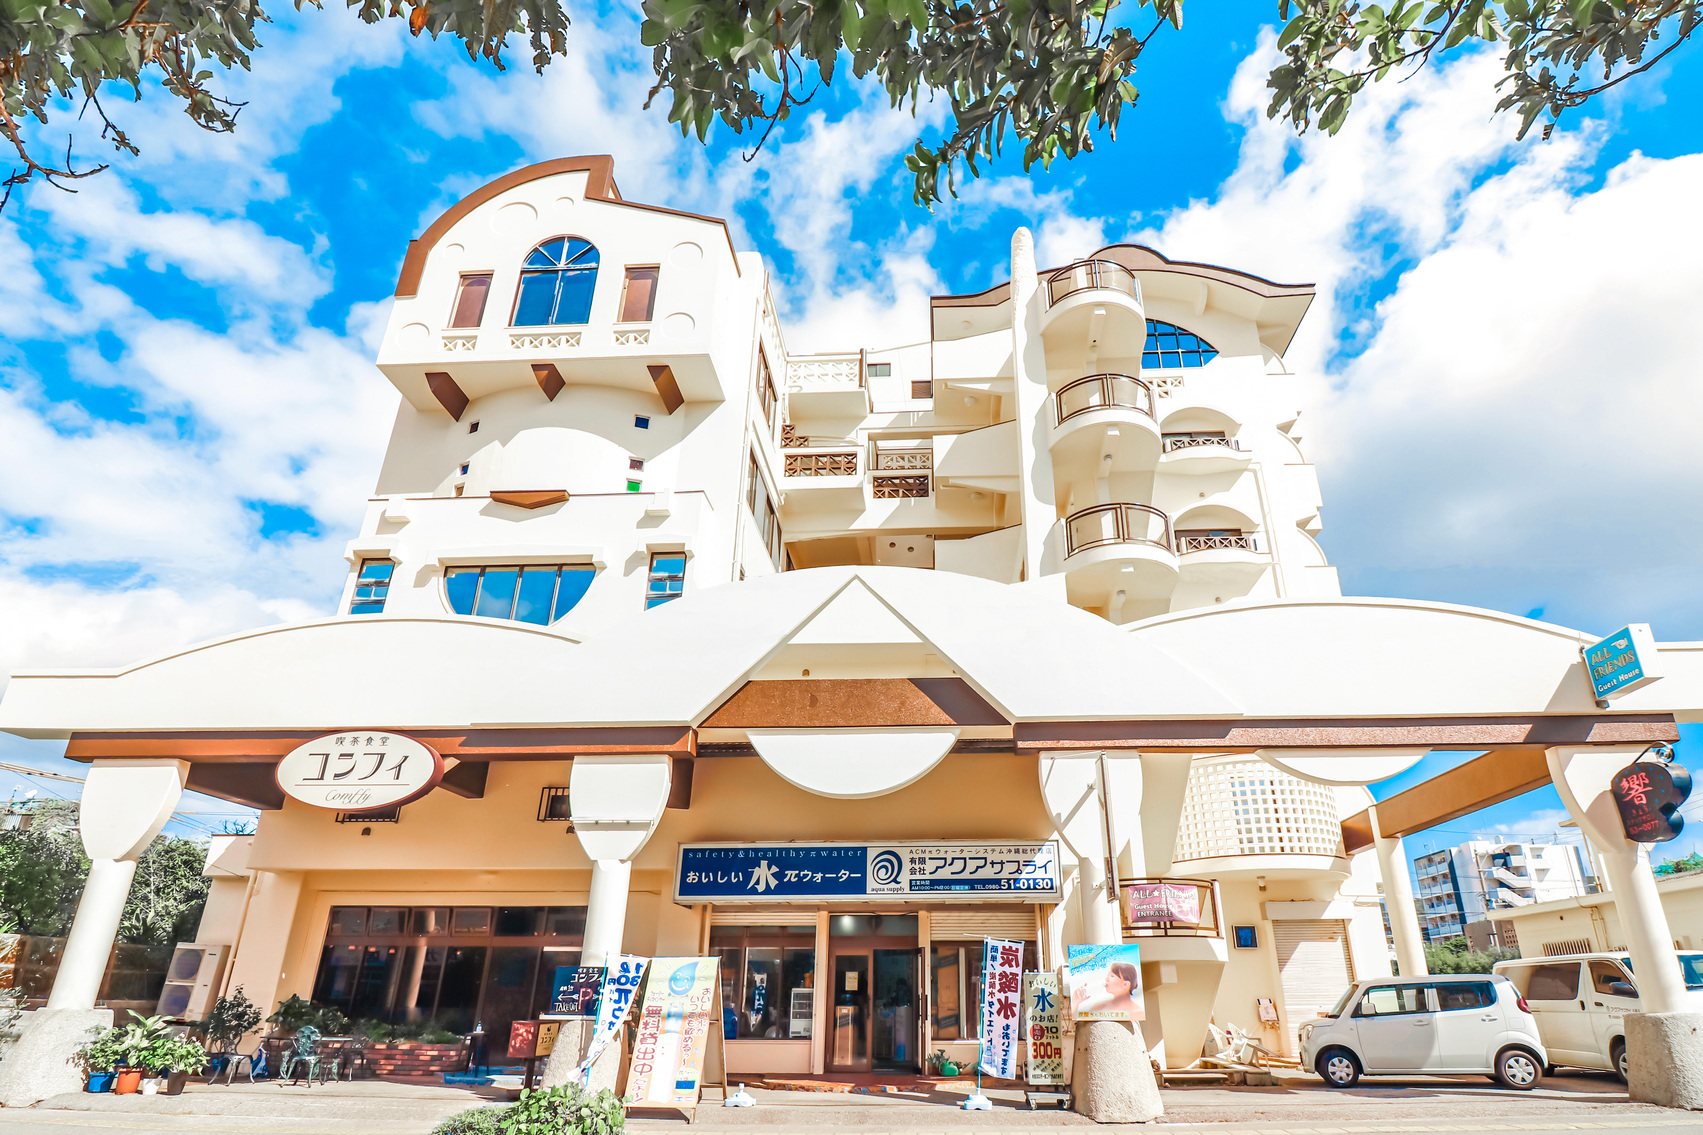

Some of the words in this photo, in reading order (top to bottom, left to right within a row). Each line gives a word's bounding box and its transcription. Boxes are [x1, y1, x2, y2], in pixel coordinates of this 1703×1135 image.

[1591, 647, 1612, 666] ALL
[1593, 649, 1635, 681] FRIENDS
[1598, 679, 1617, 692] Guest
[1618, 668, 1640, 682] House
[335, 736, 390, 746] 喫茶食堂
[302, 752, 409, 781] コンフィ
[1620, 772, 1653, 805] 響
[928, 857, 1052, 875] アクアサプライ
[1137, 910, 1174, 918] ENTRANCE
[1033, 987, 1055, 1013] 水
[1032, 1042, 1062, 1059] 300円
